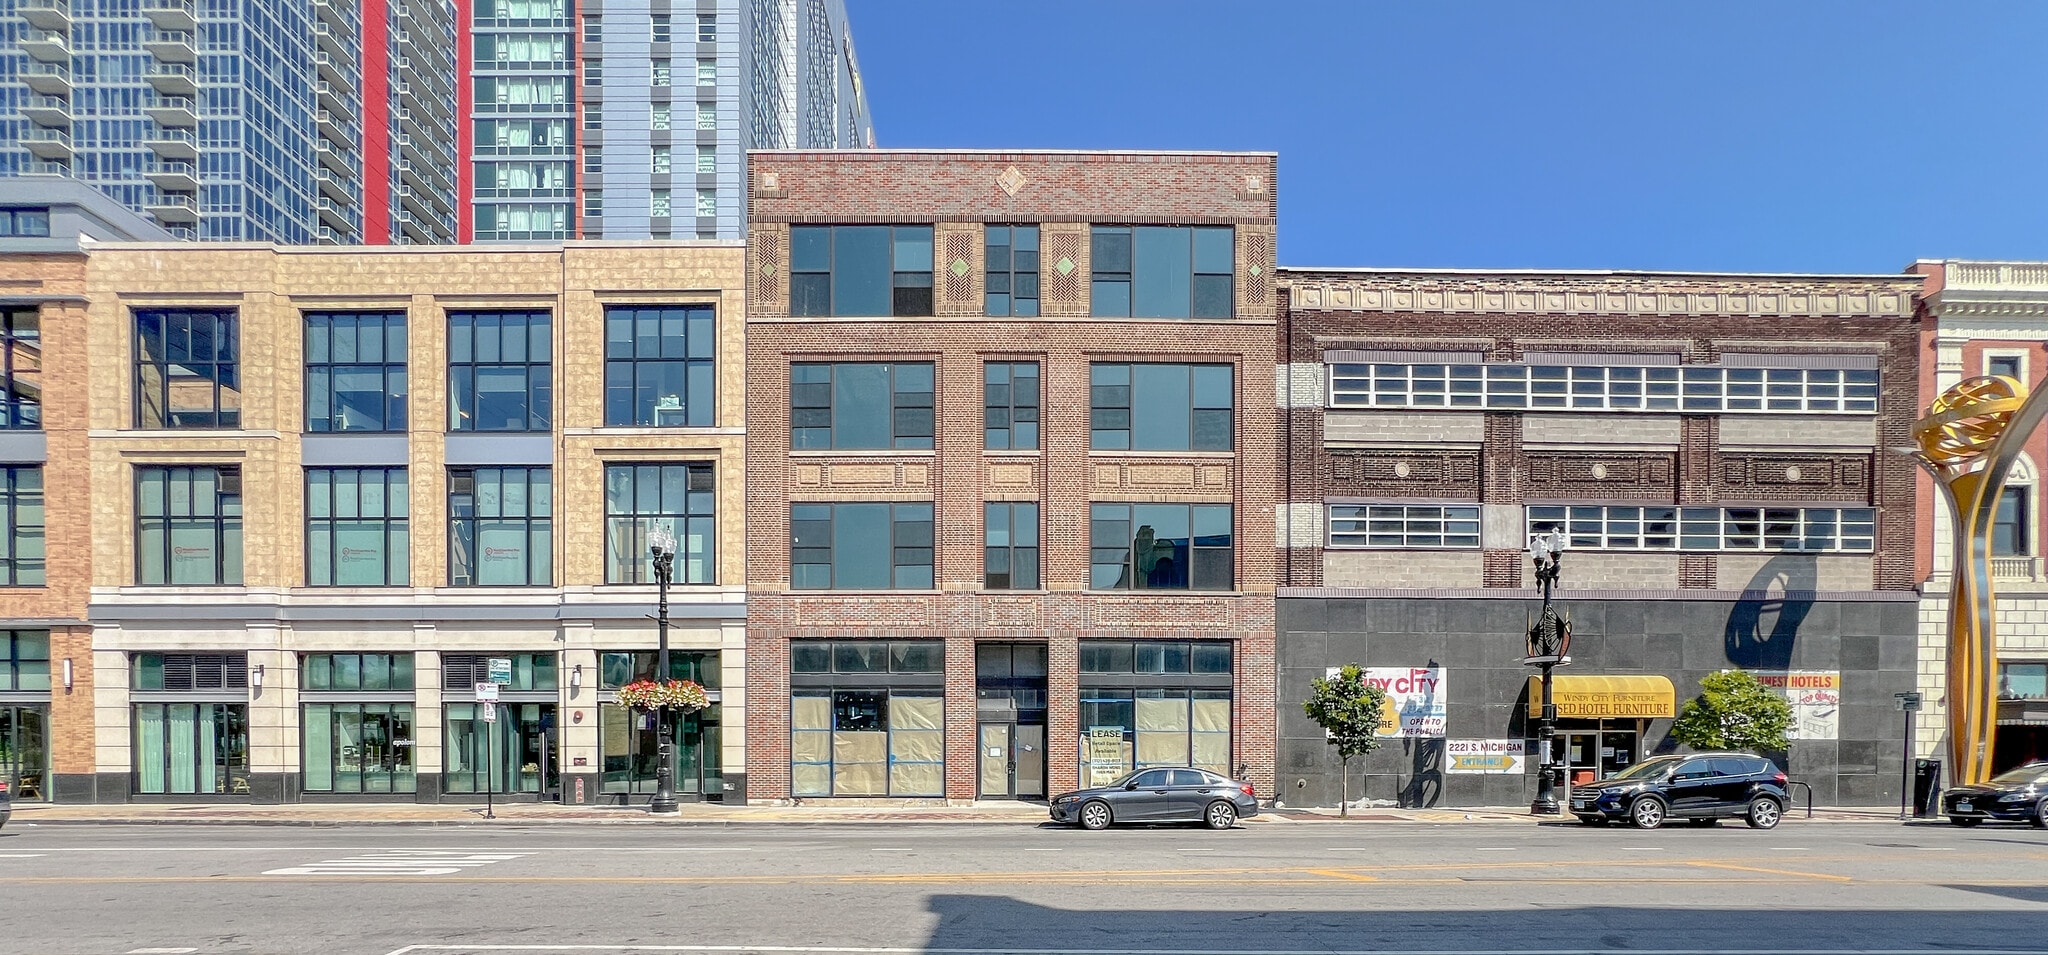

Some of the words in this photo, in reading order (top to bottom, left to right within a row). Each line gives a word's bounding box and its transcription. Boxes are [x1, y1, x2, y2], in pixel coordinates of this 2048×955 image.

[1395, 669, 1440, 693] CITY
[1791, 676, 1832, 688] HOTELS
[1563, 694, 1589, 702] WINDY
[1591, 694, 1610, 702] CITY
[1613, 694, 1656, 702] FURNITURE
[1801, 694, 1814, 704] TOP
[1557, 703, 1577, 714] SED
[1580, 703, 1611, 714] HOTEL
[1613, 703, 1669, 714] FURNITURE
[1092, 730, 1121, 738] LEASE
[1449, 743, 1468, 751] 2221
[1471, 743, 1478, 751] S.
[1480, 743, 1522, 752] MICHIGAN
[1462, 757, 1503, 766] ENTRANCE
